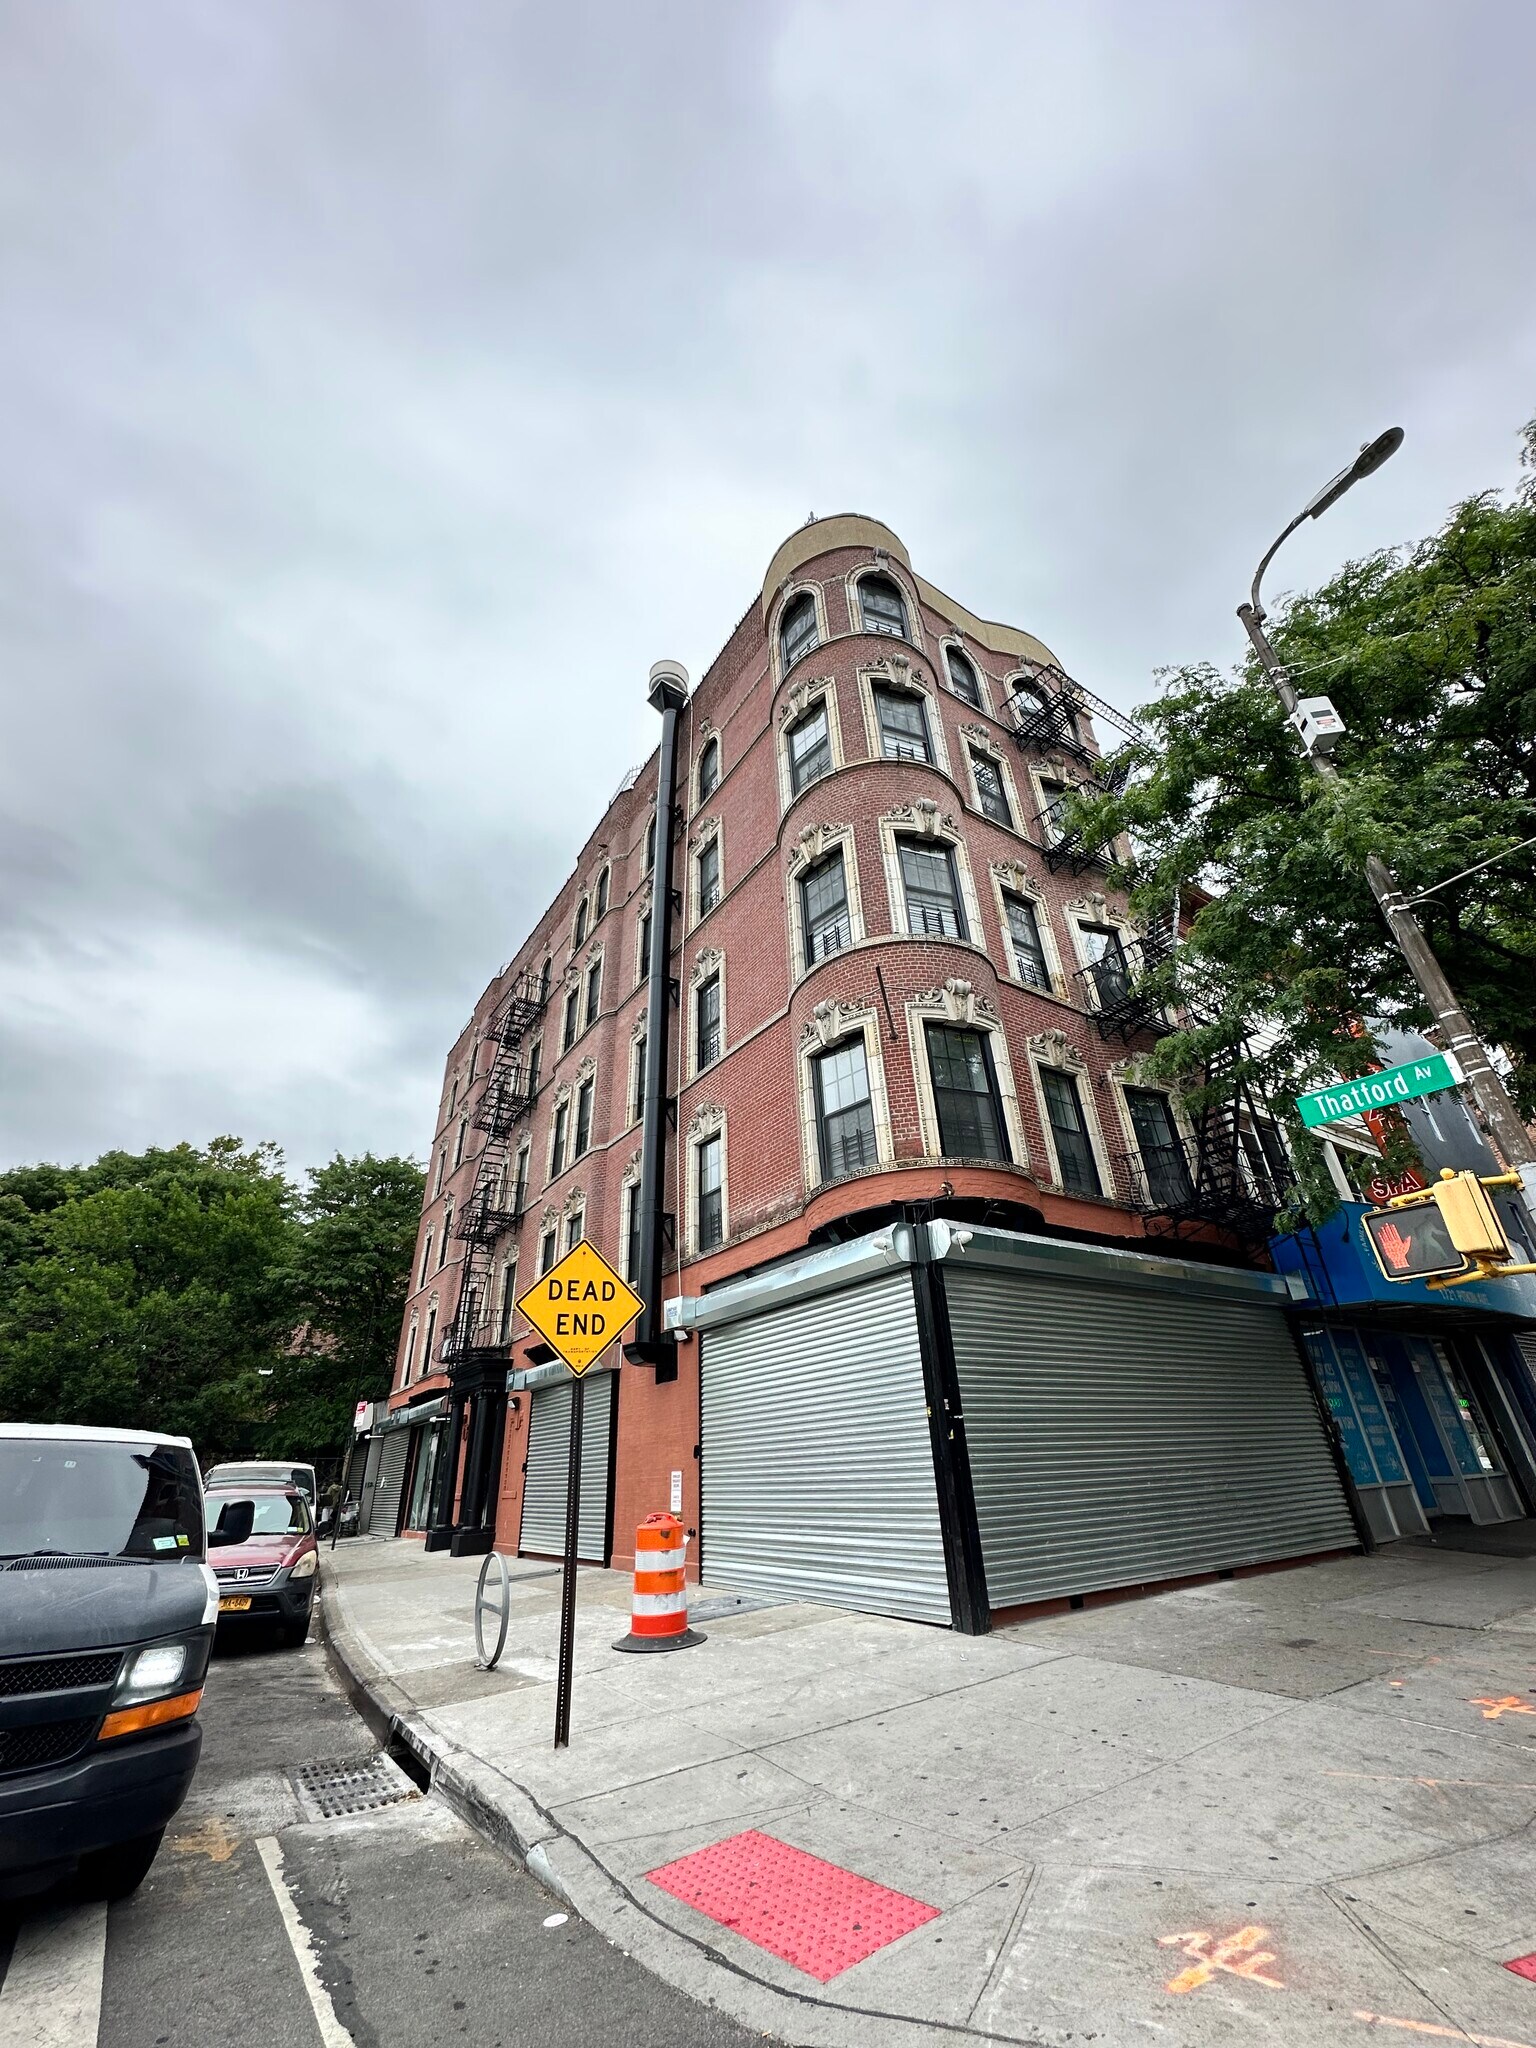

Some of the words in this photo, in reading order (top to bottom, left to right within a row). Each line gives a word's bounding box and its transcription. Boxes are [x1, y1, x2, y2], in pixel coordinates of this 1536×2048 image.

[1313, 1071, 1410, 1118] Thatford
[1414, 1064, 1432, 1081] Av
[548, 1279, 616, 1302] DEAD
[556, 1313, 606, 1336] END
